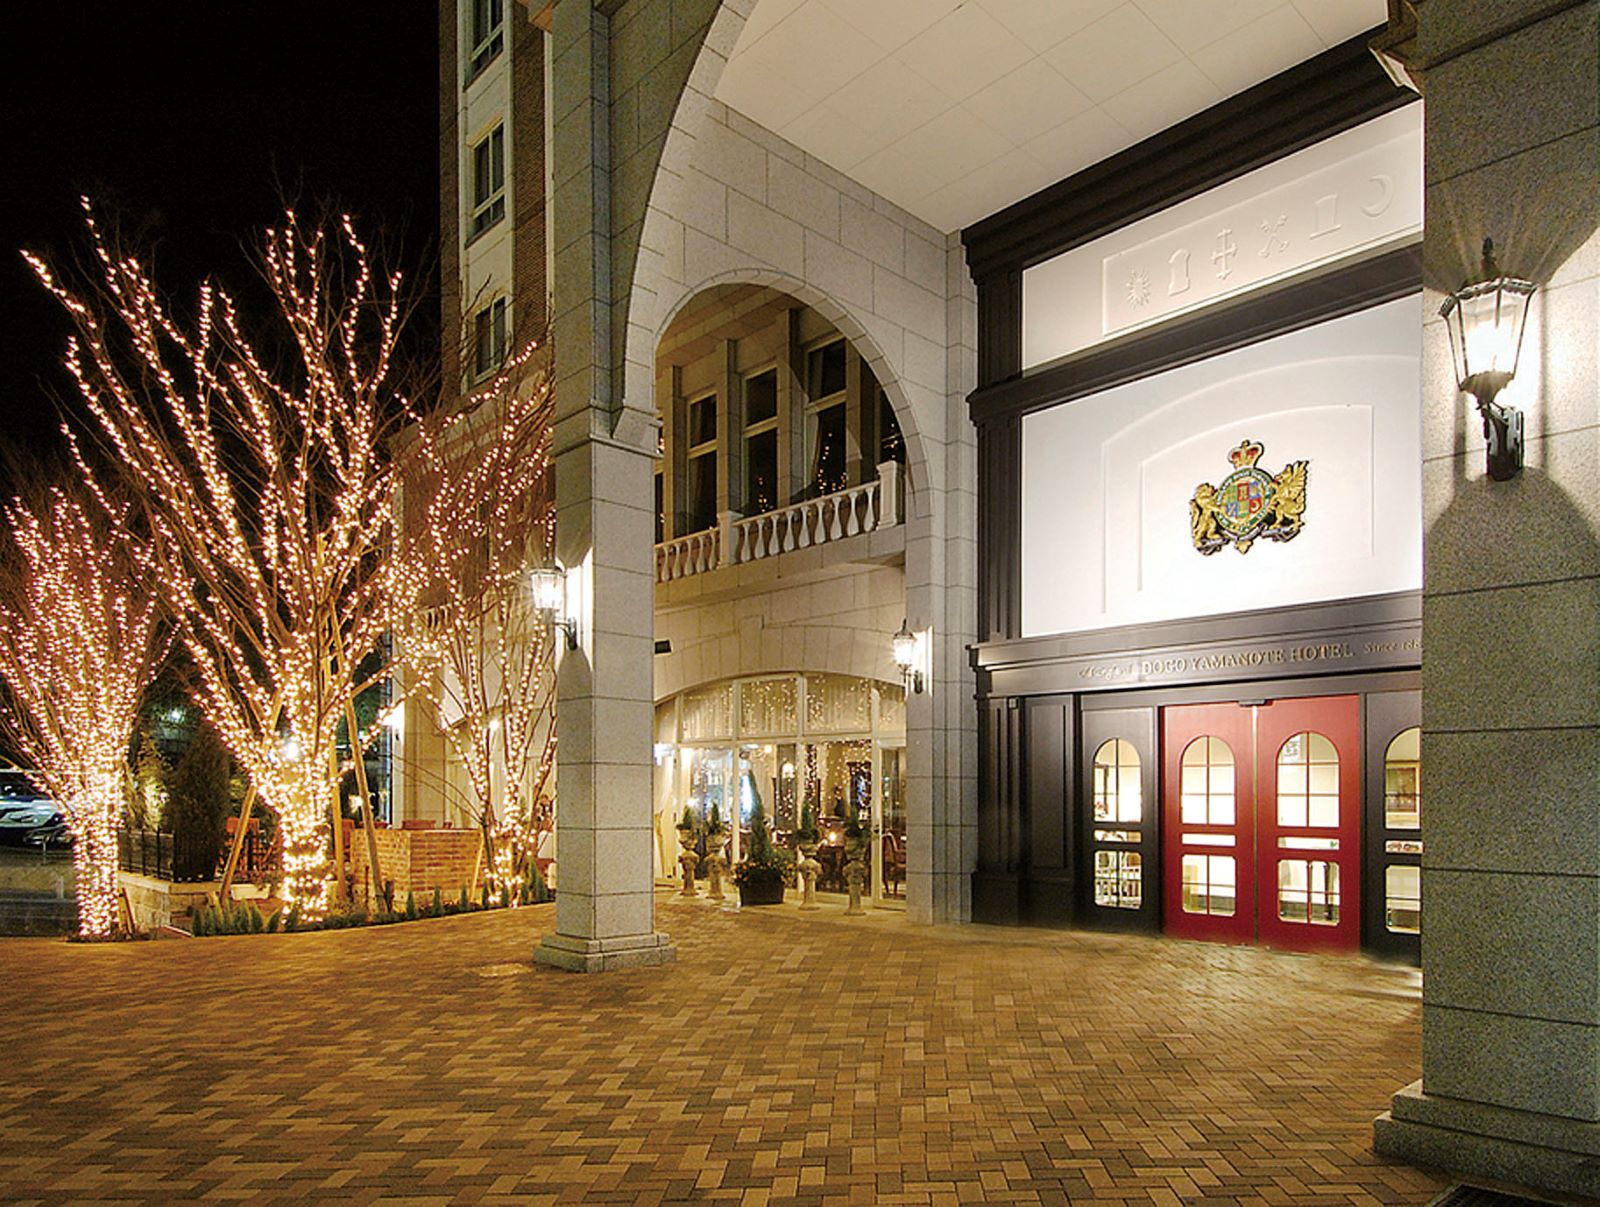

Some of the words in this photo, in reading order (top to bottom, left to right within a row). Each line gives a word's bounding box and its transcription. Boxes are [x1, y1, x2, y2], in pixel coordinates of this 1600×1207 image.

[1142, 657, 1186, 676] DOGO
[1191, 650, 1285, 671] YAMANOTE
[1290, 643, 1355, 663] HOTEL
